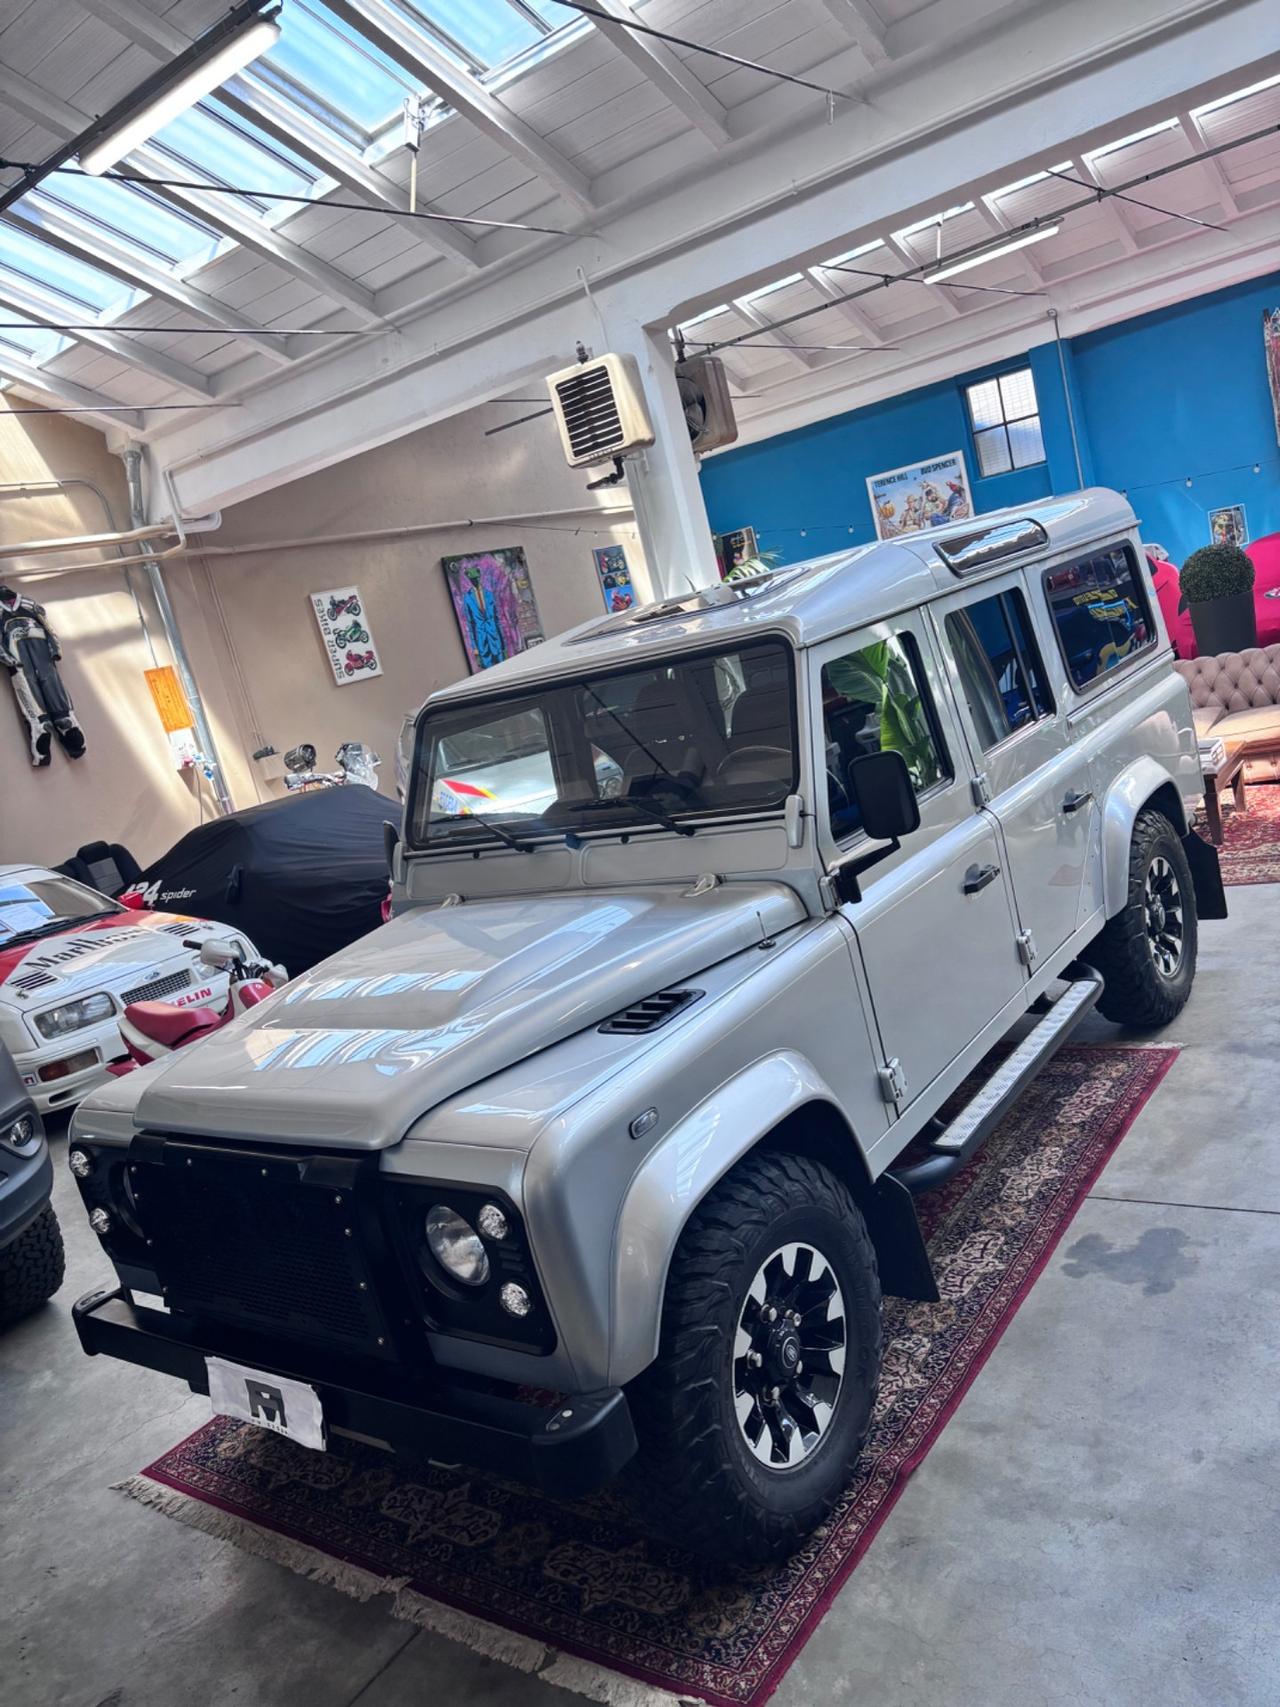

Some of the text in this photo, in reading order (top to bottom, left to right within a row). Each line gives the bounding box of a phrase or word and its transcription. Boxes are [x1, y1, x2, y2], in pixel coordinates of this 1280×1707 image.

[874, 458, 957, 488] TERENCE HILL BUD SPENCER
[314, 598, 345, 679] SUPER BIKES
[160, 887, 196, 903] spider
[173, 987, 213, 1008] ELIN
